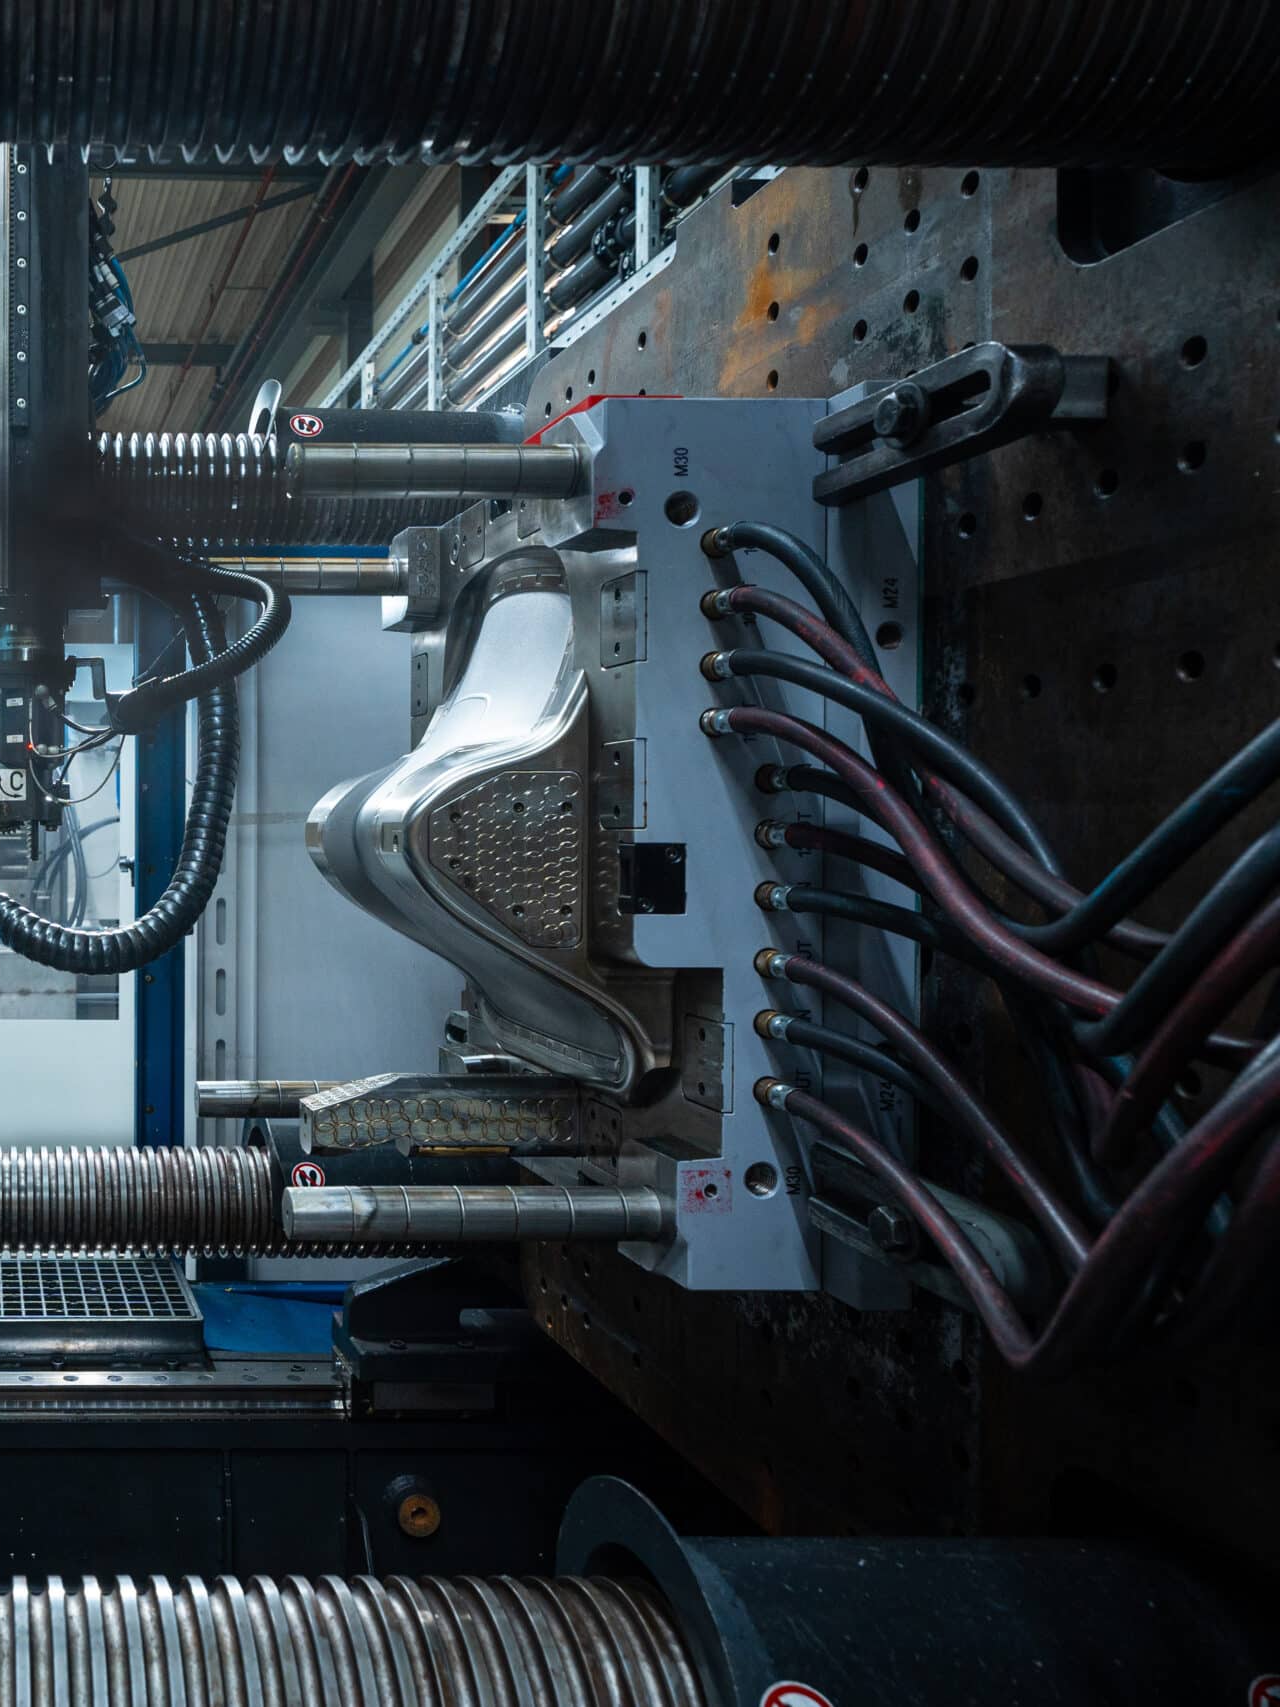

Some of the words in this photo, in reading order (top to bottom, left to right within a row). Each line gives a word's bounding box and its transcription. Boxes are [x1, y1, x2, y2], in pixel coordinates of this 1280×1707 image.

[674, 447, 689, 477] M30
[882, 578, 898, 608] M24
[10, 771, 24, 791] C
[787, 1166, 801, 1195] M30
